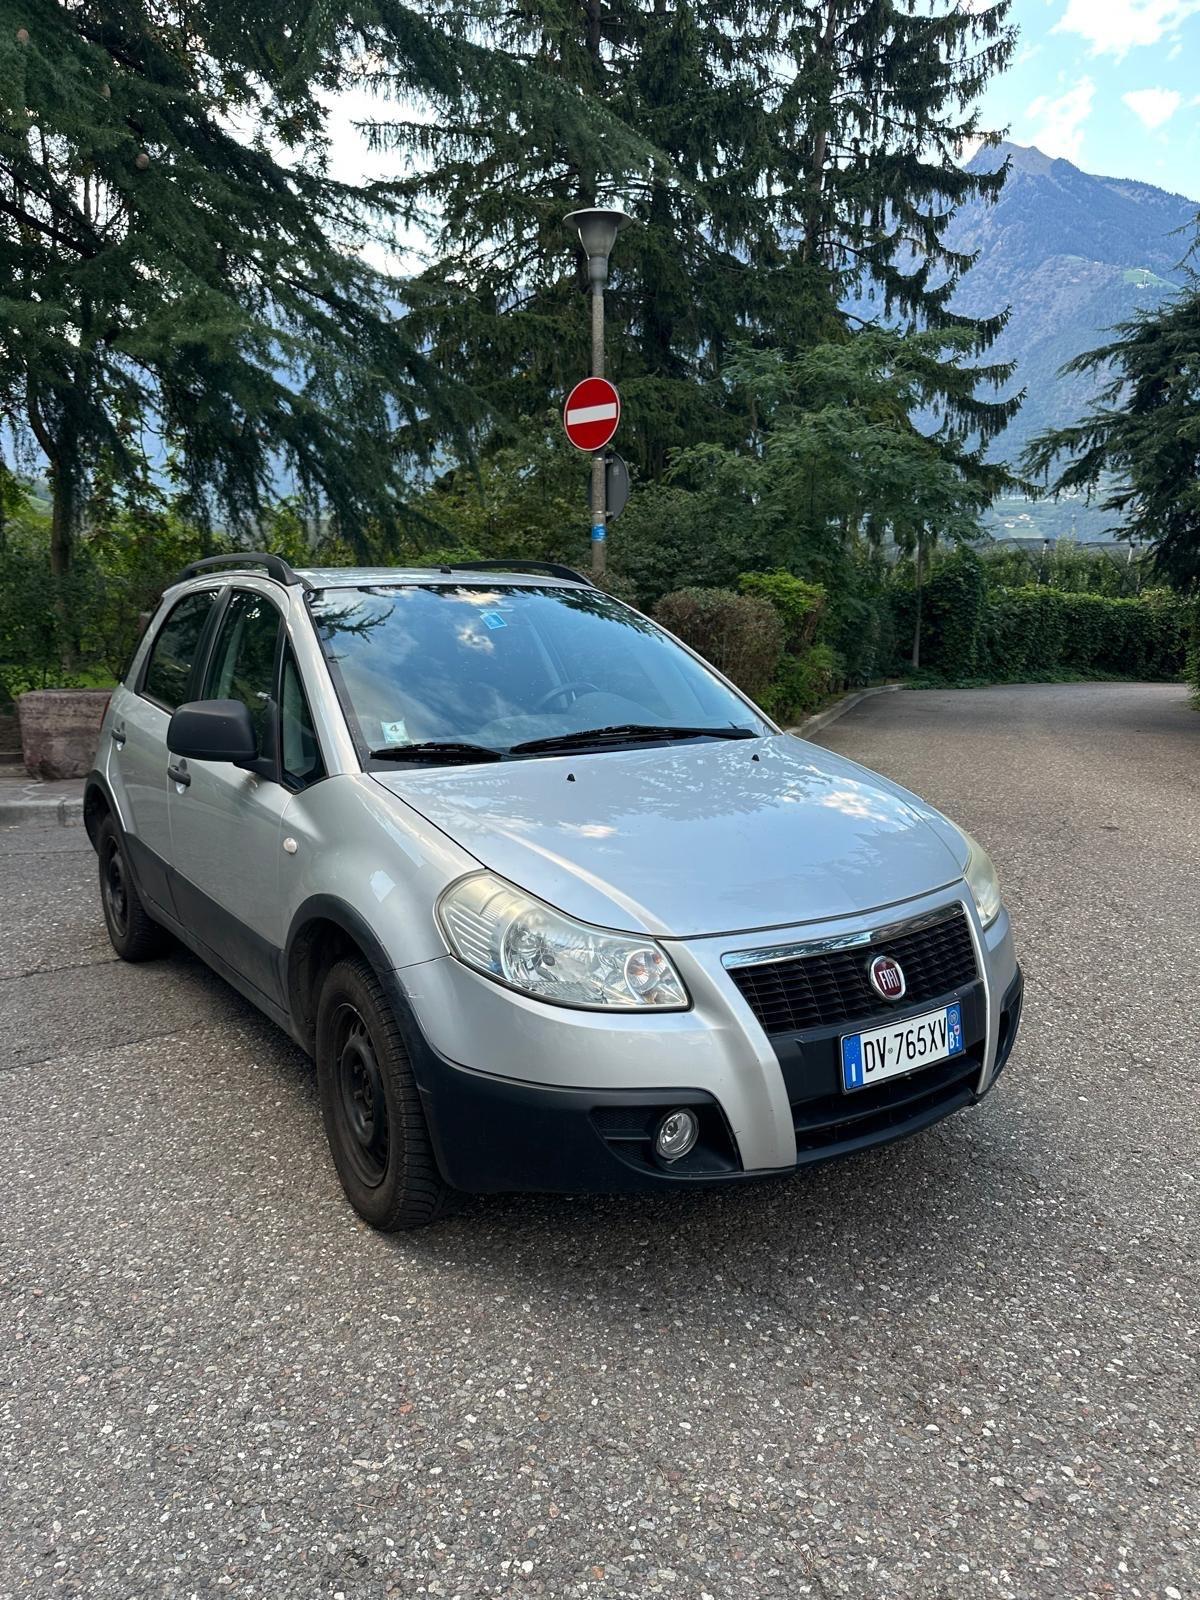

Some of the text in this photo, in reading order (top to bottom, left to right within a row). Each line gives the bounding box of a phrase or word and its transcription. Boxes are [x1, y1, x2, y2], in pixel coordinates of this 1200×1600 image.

[878, 968, 900, 990] FIAT
[864, 1018, 947, 1073] DV 765XV
[851, 1063, 857, 1082] I
